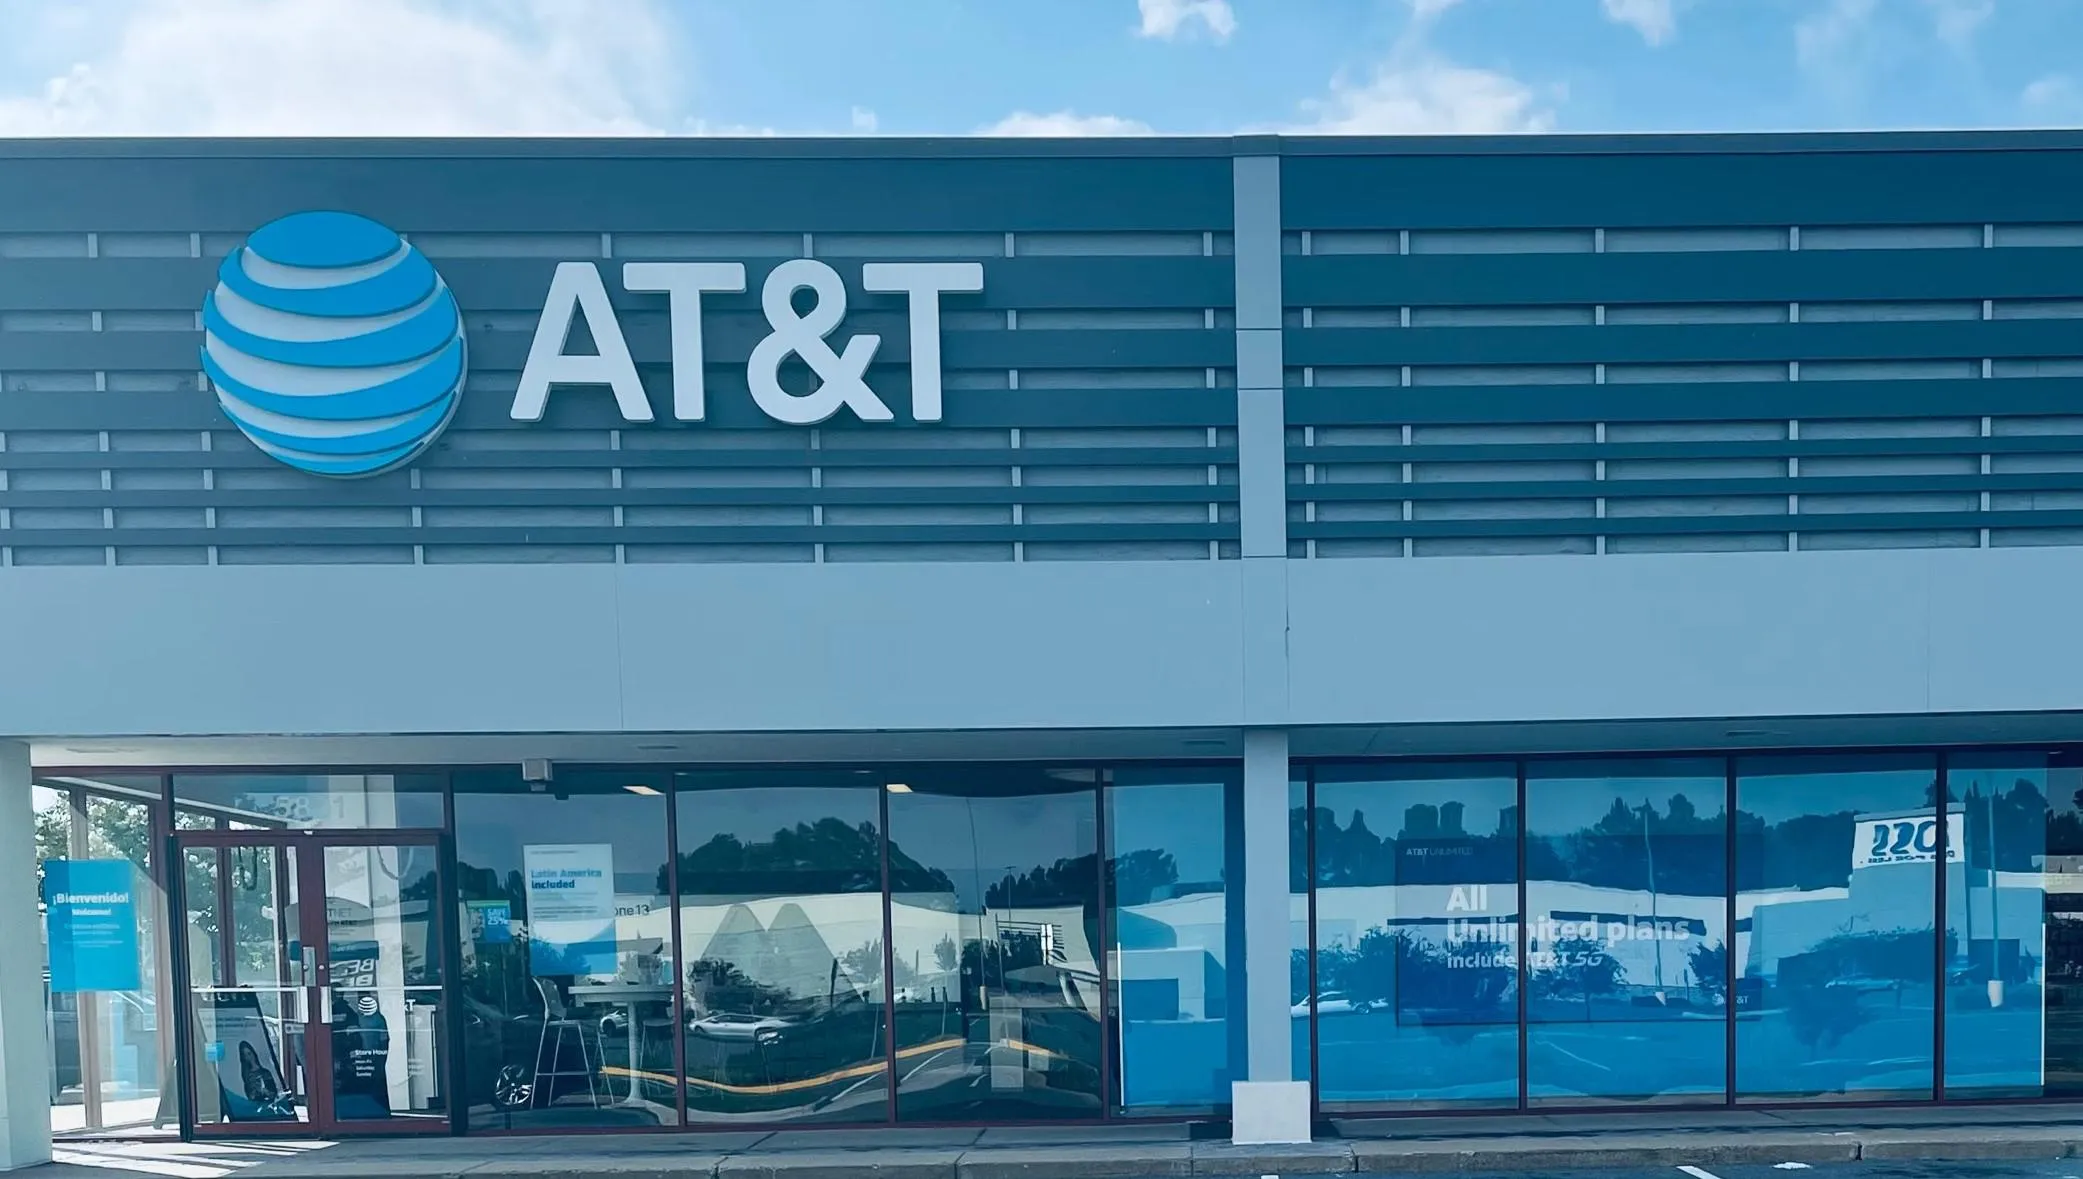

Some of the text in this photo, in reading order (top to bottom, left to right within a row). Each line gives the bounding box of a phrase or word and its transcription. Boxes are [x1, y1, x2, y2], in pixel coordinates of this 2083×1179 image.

[510, 259, 984, 425] AT&T
[1406, 847, 1429, 856] AT&T
[531, 868, 602, 878] Latin America
[53, 892, 129, 906] ¡Bienvenido!
[1446, 884, 1488, 912] All
[636, 904, 650, 917] 13
[1447, 915, 1690, 948] Unlimited plans
[1447, 952, 1518, 968] include
[1573, 951, 1604, 966] 5G
